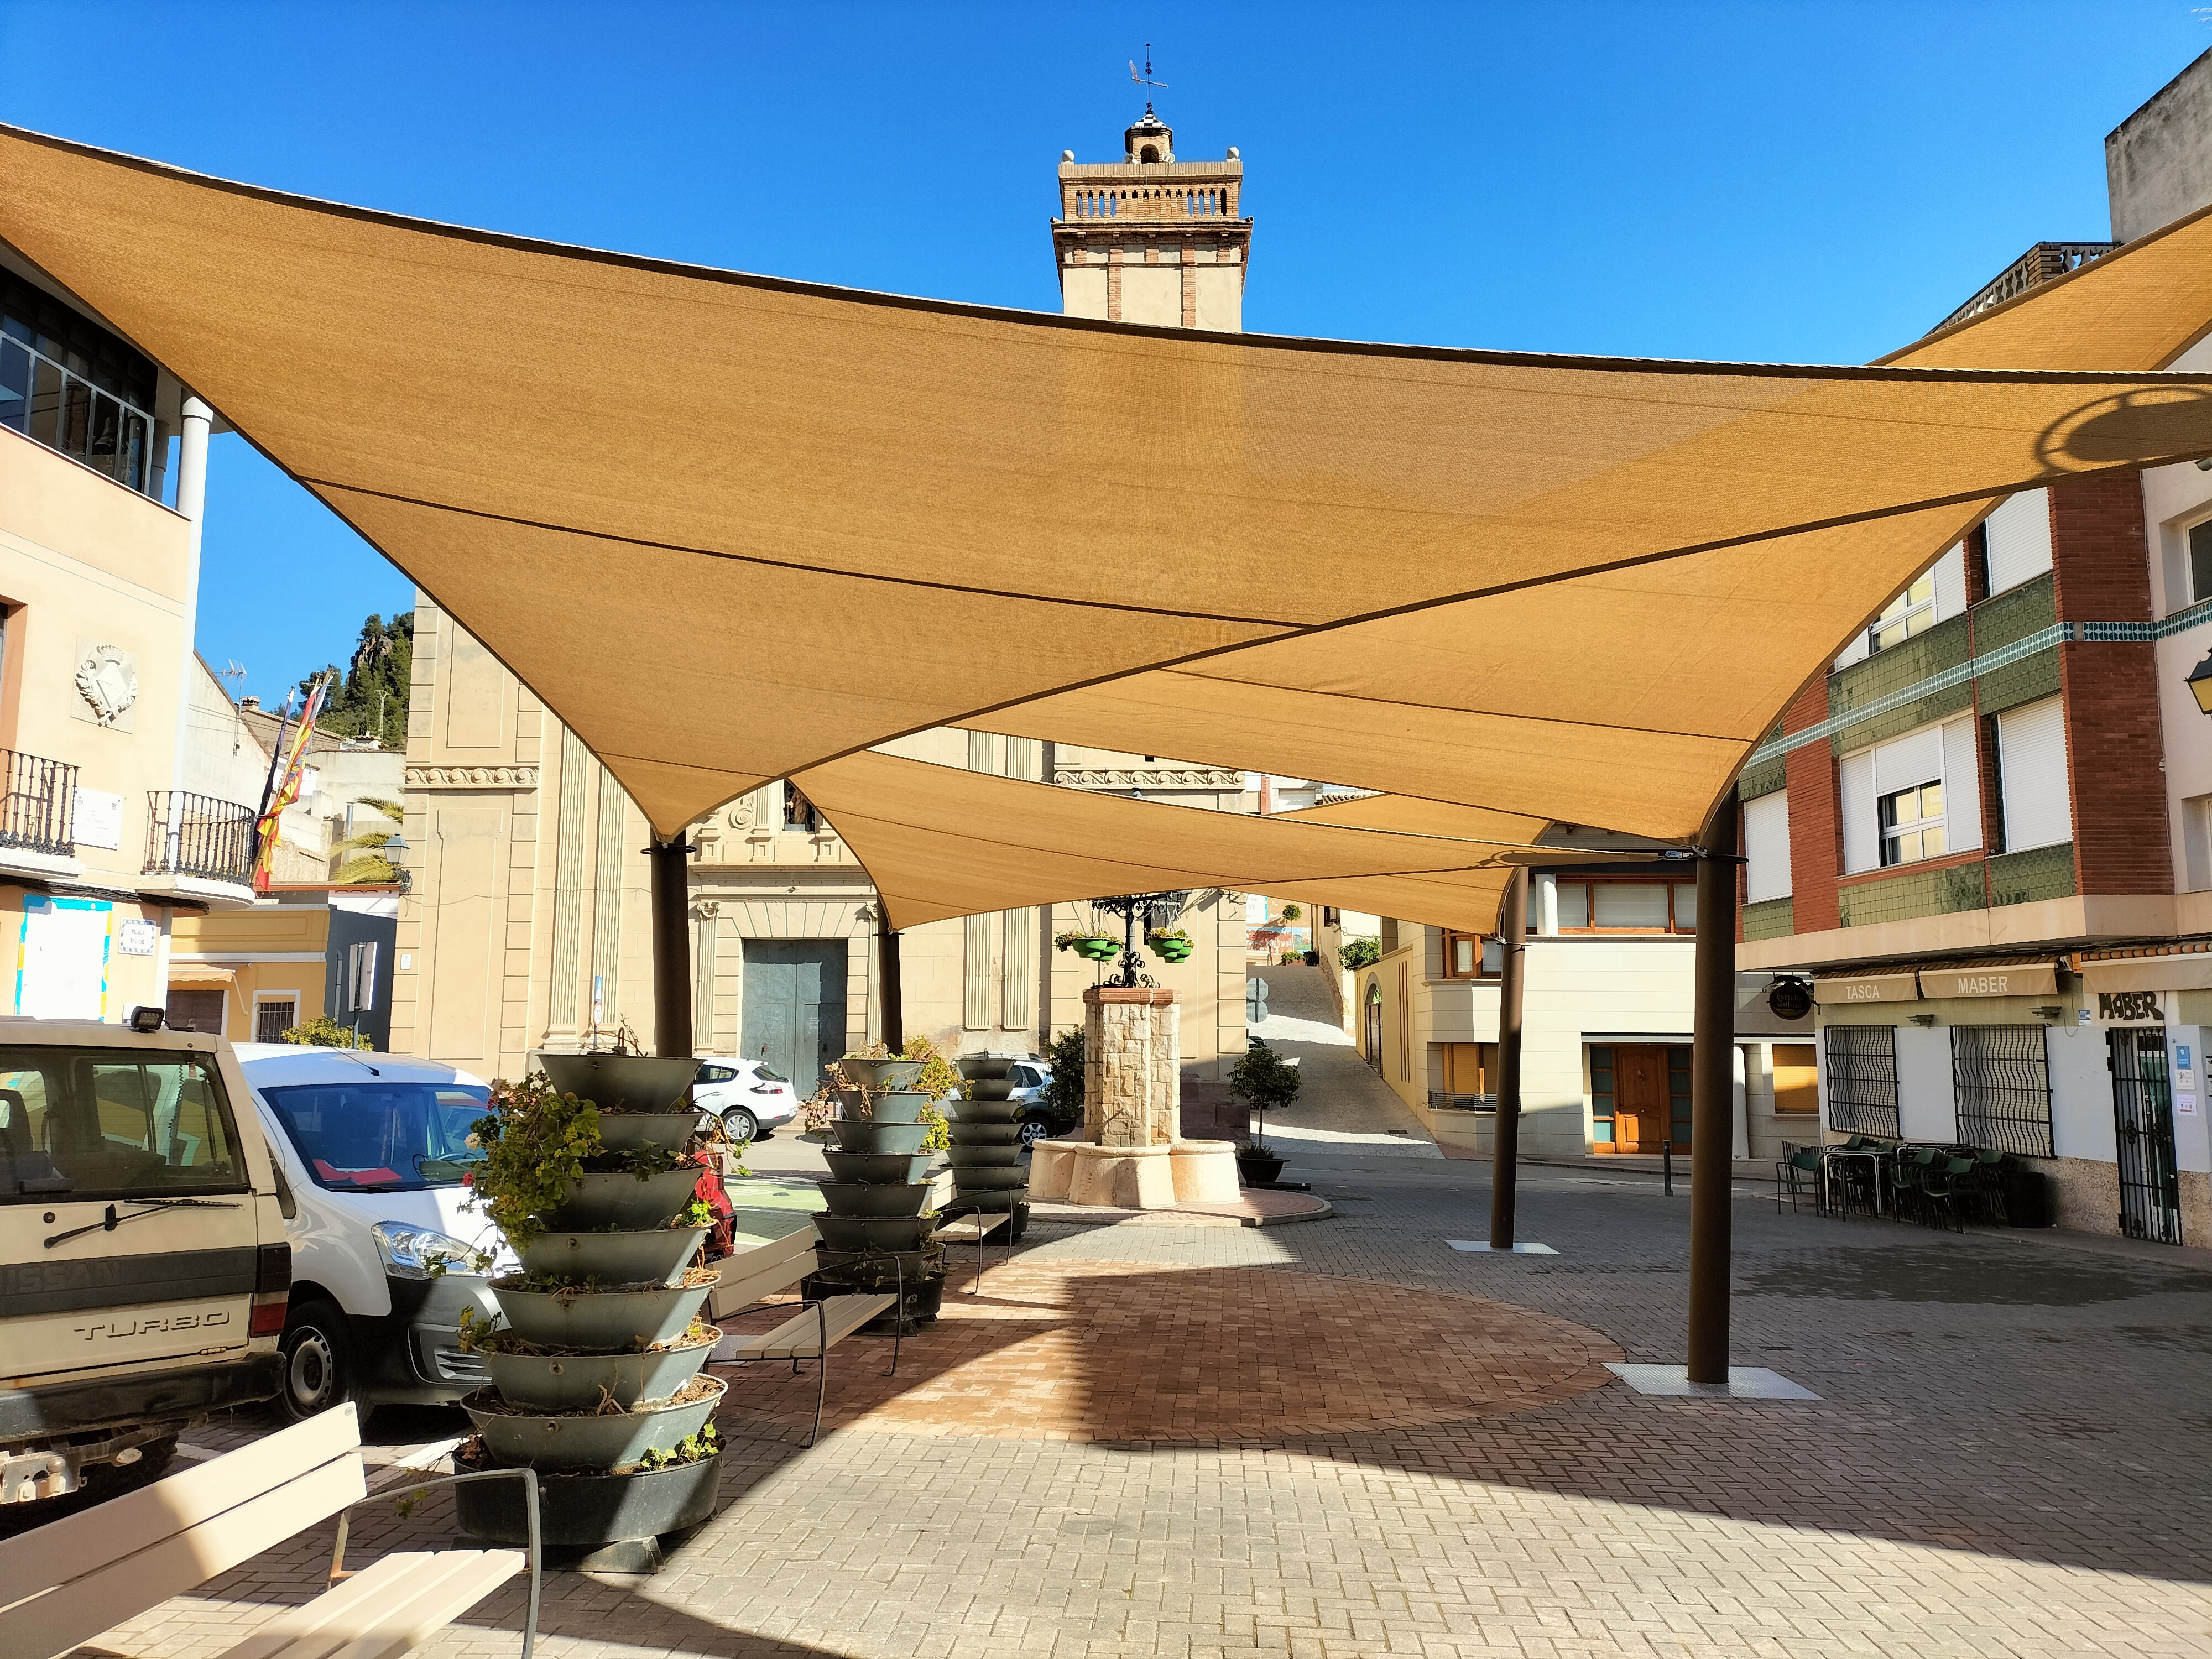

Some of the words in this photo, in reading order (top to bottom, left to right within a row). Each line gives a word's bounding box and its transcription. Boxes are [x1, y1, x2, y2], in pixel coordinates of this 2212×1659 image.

[1929, 794, 1942, 804] Vend
[1845, 984, 1880, 999] TASCA
[1958, 976, 2008, 994] MABER
[1777, 1000, 1802, 1008] Galicia
[2098, 991, 2165, 1021] MABER
[74, 1311, 230, 1341] TURBO
